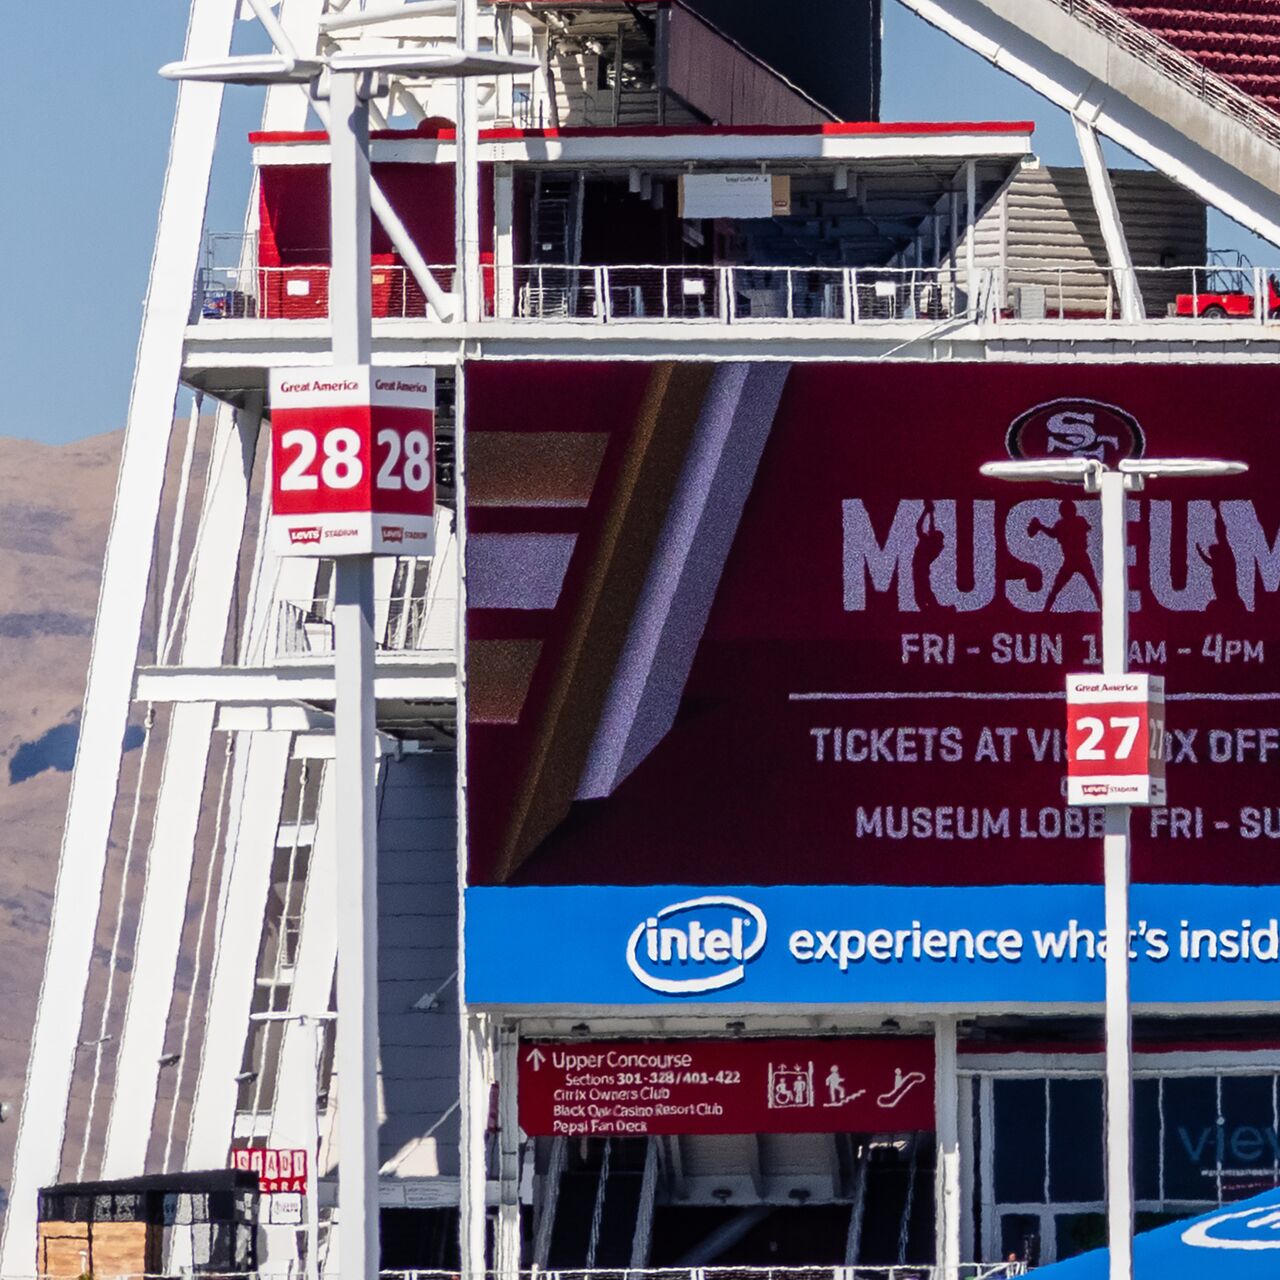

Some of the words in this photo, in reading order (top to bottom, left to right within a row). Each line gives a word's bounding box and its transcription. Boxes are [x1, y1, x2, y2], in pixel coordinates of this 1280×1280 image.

[280, 381, 310, 393] Great
[312, 380, 359, 391] America
[375, 379, 395, 391] Great
[395, 381, 427, 393] America
[280, 427, 363, 491] 28
[376, 428, 431, 492] 28
[325, 529, 359, 538] STADIUM
[900, 633, 956, 665] FRI
[991, 632, 1063, 665] SUN
[1082, 634, 1167, 666] 1AM
[1201, 634, 1265, 665] 4PM
[1075, 684, 1099, 692] Great
[1101, 684, 1138, 692] America
[809, 727, 963, 763] TICKETS
[975, 728, 1018, 763] AT
[1076, 716, 1140, 760] 27
[856, 807, 1010, 839] MUSEUM
[1019, 807, 1105, 839] LOBB
[1151, 807, 1202, 839] FRI
[646, 917, 745, 962] intel
[789, 919, 1023, 972] experience
[552, 1052, 604, 1071] Upper
[607, 1050, 693, 1069] Concourse
[565, 1073, 614, 1086] Sections
[553, 1089, 586, 1101] Citrix
[589, 1088, 639, 1101] Owners
[640, 1086, 670, 1100] Club
[553, 1105, 585, 1117] Black
[587, 1104, 612, 1117] Oak
[613, 1104, 653, 1117] Casino
[655, 1103, 695, 1116] Resort
[696, 1102, 724, 1115] Club
[553, 1120, 588, 1135] Pepsi
[591, 1120, 614, 1133] Fan
[616, 1120, 648, 1133] Deck
